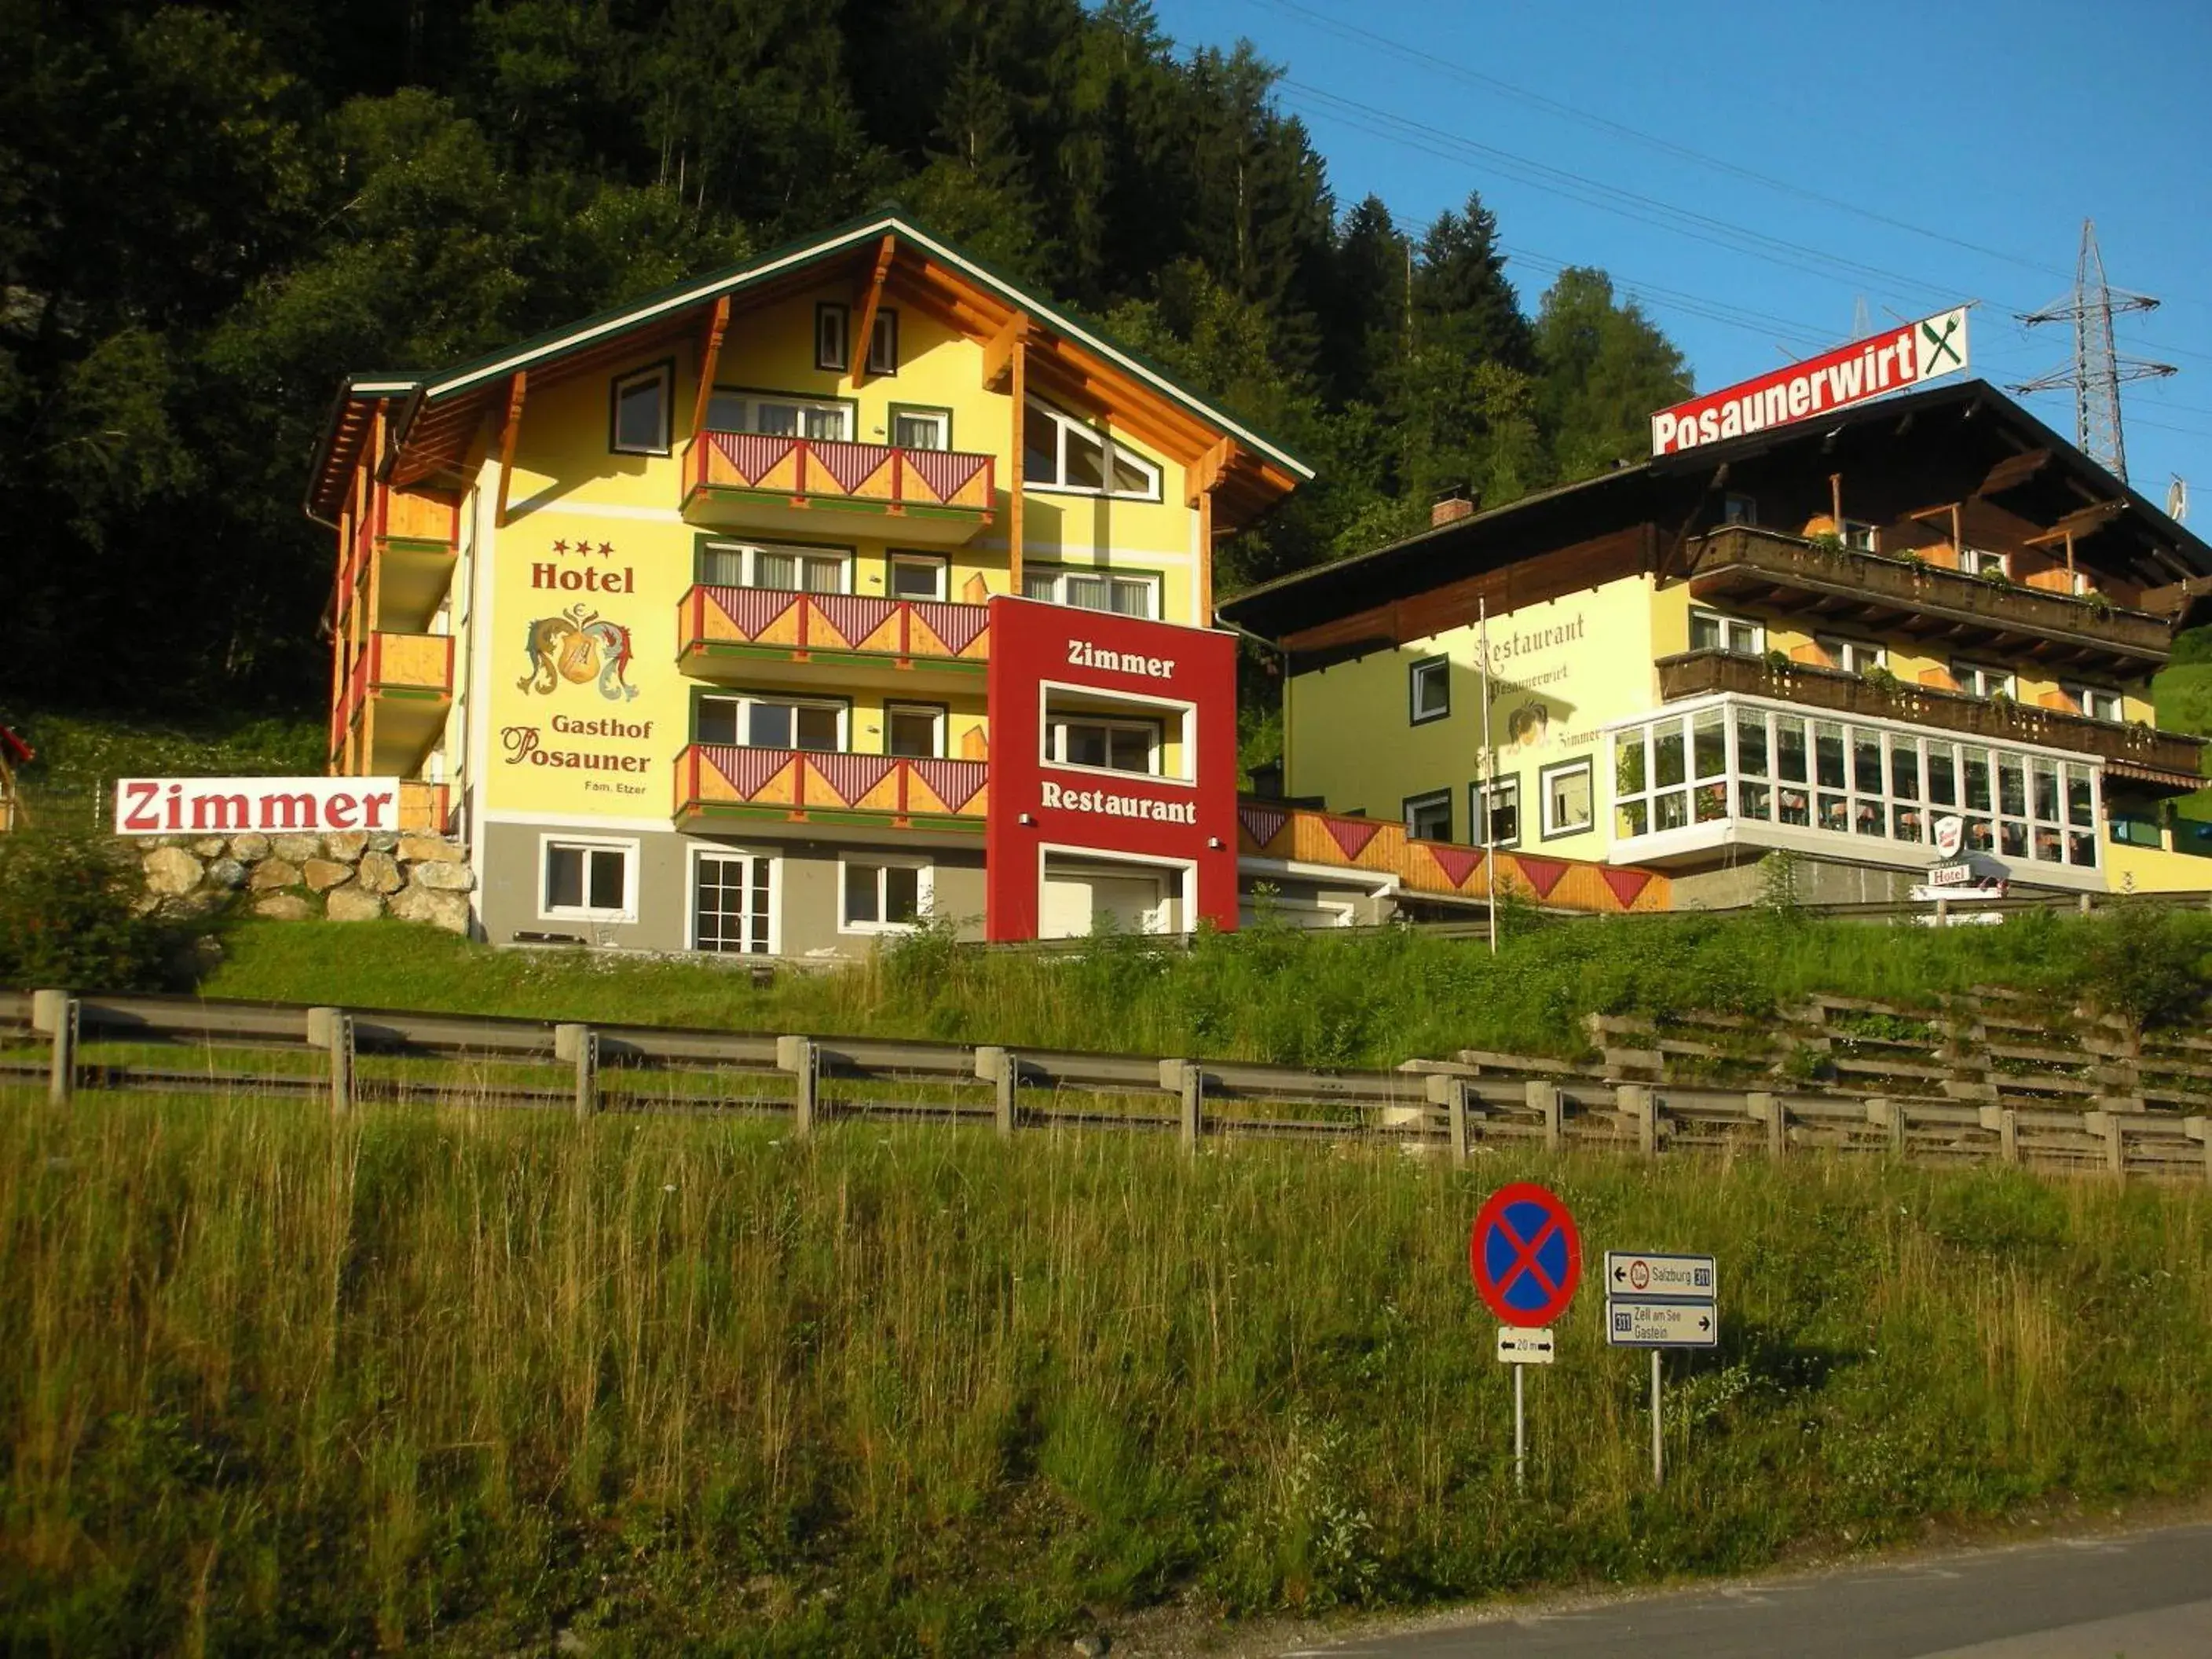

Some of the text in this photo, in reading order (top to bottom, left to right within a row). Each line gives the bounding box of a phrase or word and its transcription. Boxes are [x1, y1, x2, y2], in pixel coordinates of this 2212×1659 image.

[1653, 332, 1915, 456] Posaunerwirt
[531, 562, 635, 593] Hotel
[1068, 639, 1175, 679] Zimmer
[1474, 612, 1584, 676] Restaurant
[551, 714, 654, 739] Gasthof
[501, 726, 651, 773] Posauner
[584, 781, 646, 796] Fam. Etzer
[1042, 782, 1196, 824] Restaurant
[123, 782, 393, 830] Zimmer
[1934, 867, 1965, 884] Hotel
[1652, 1266, 1691, 1286] Salzburg
[1635, 1306, 1681, 1321] Zell am See
[1635, 1324, 1668, 1339] Gastein
